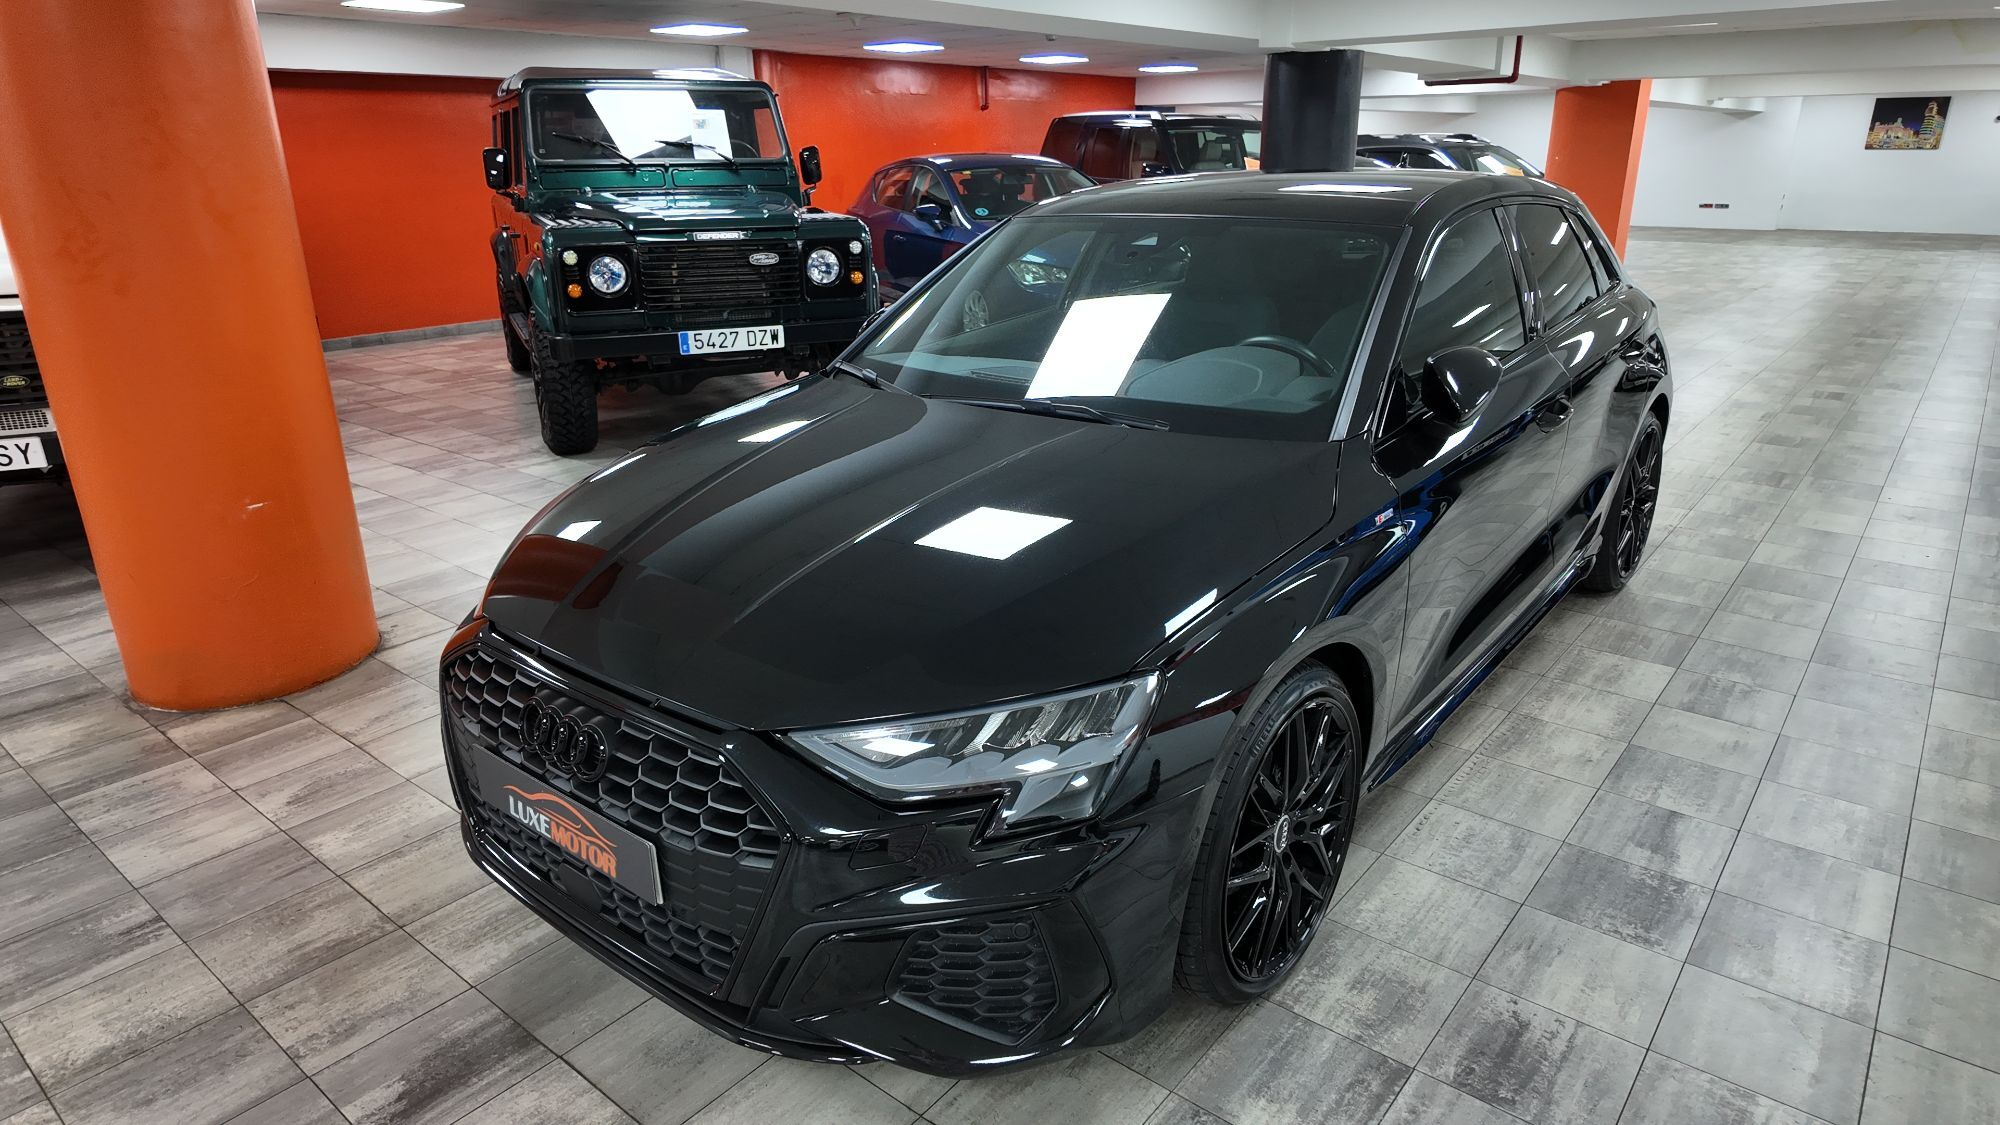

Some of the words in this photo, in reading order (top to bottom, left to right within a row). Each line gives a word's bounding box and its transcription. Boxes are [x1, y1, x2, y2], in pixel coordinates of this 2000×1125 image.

[696, 231, 740, 240] DEFENDER
[693, 331, 739, 349] 5427
[746, 328, 779, 346] DZW
[509, 795, 617, 878] LUXEMOTOR
